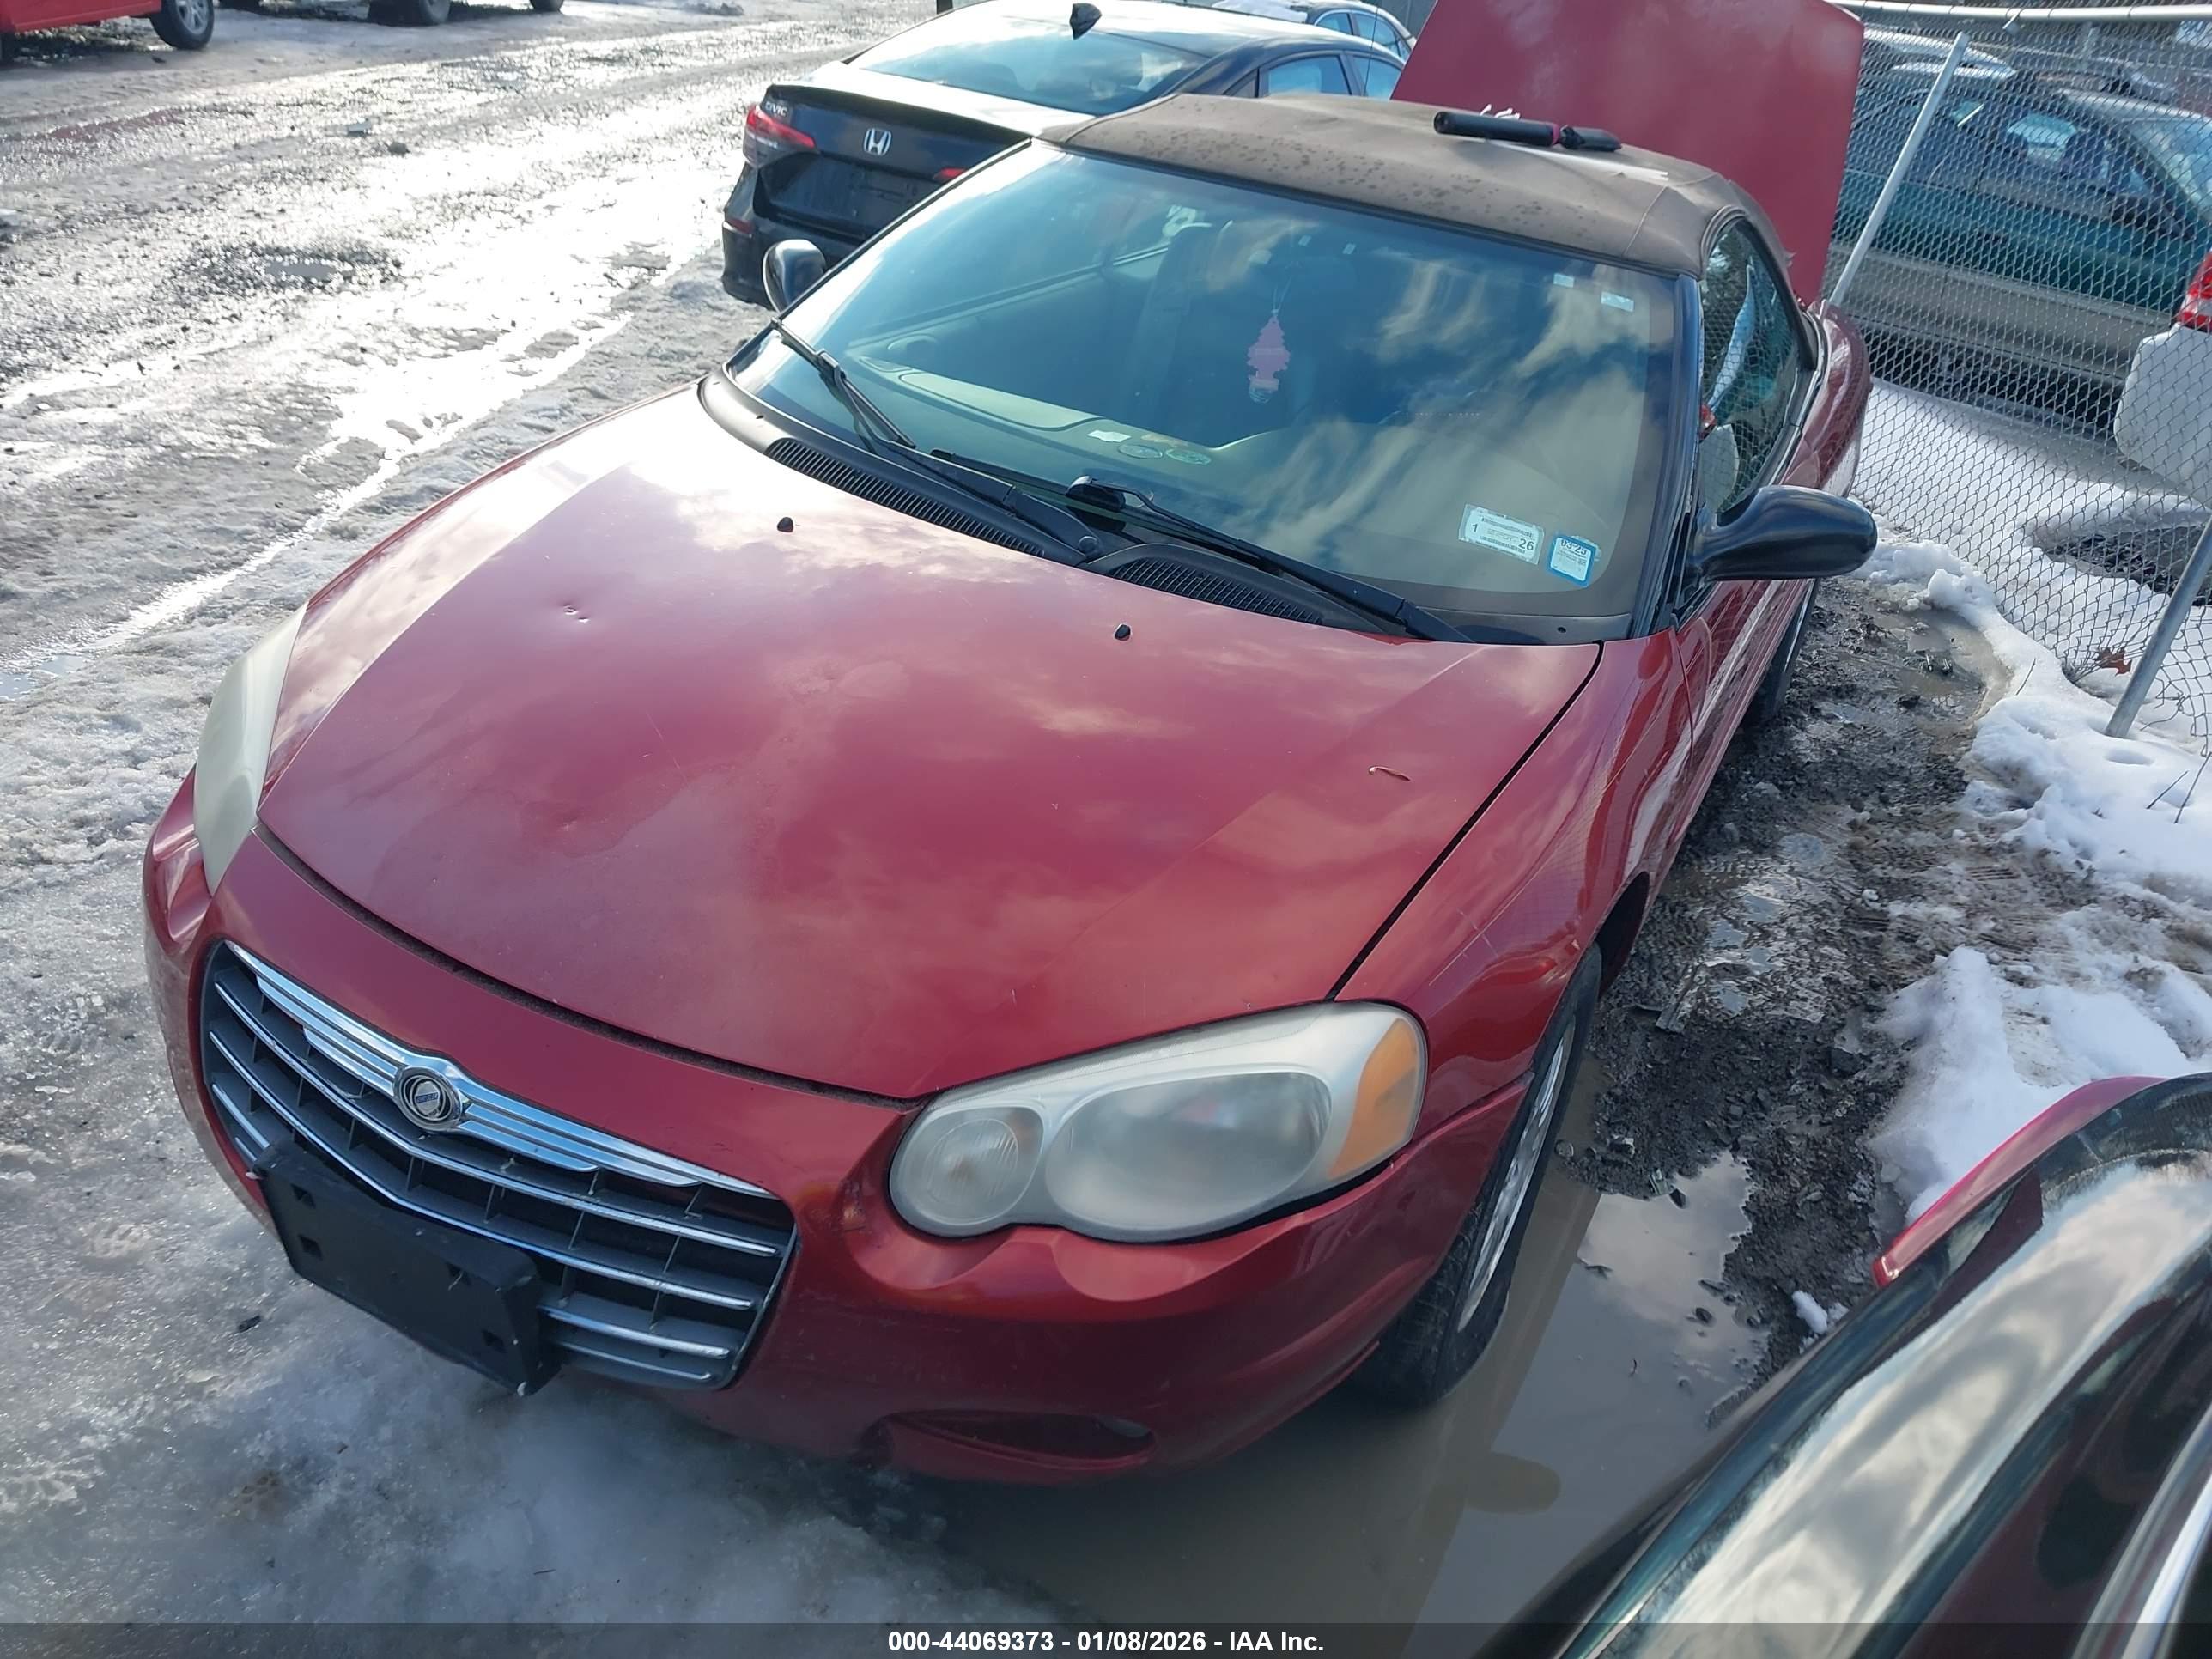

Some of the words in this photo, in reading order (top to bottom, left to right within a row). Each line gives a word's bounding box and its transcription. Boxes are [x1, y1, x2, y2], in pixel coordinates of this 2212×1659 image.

[765, 101, 787, 117] CIVIC
[1472, 523, 1479, 533] 1
[1518, 538, 1534, 551] 26
